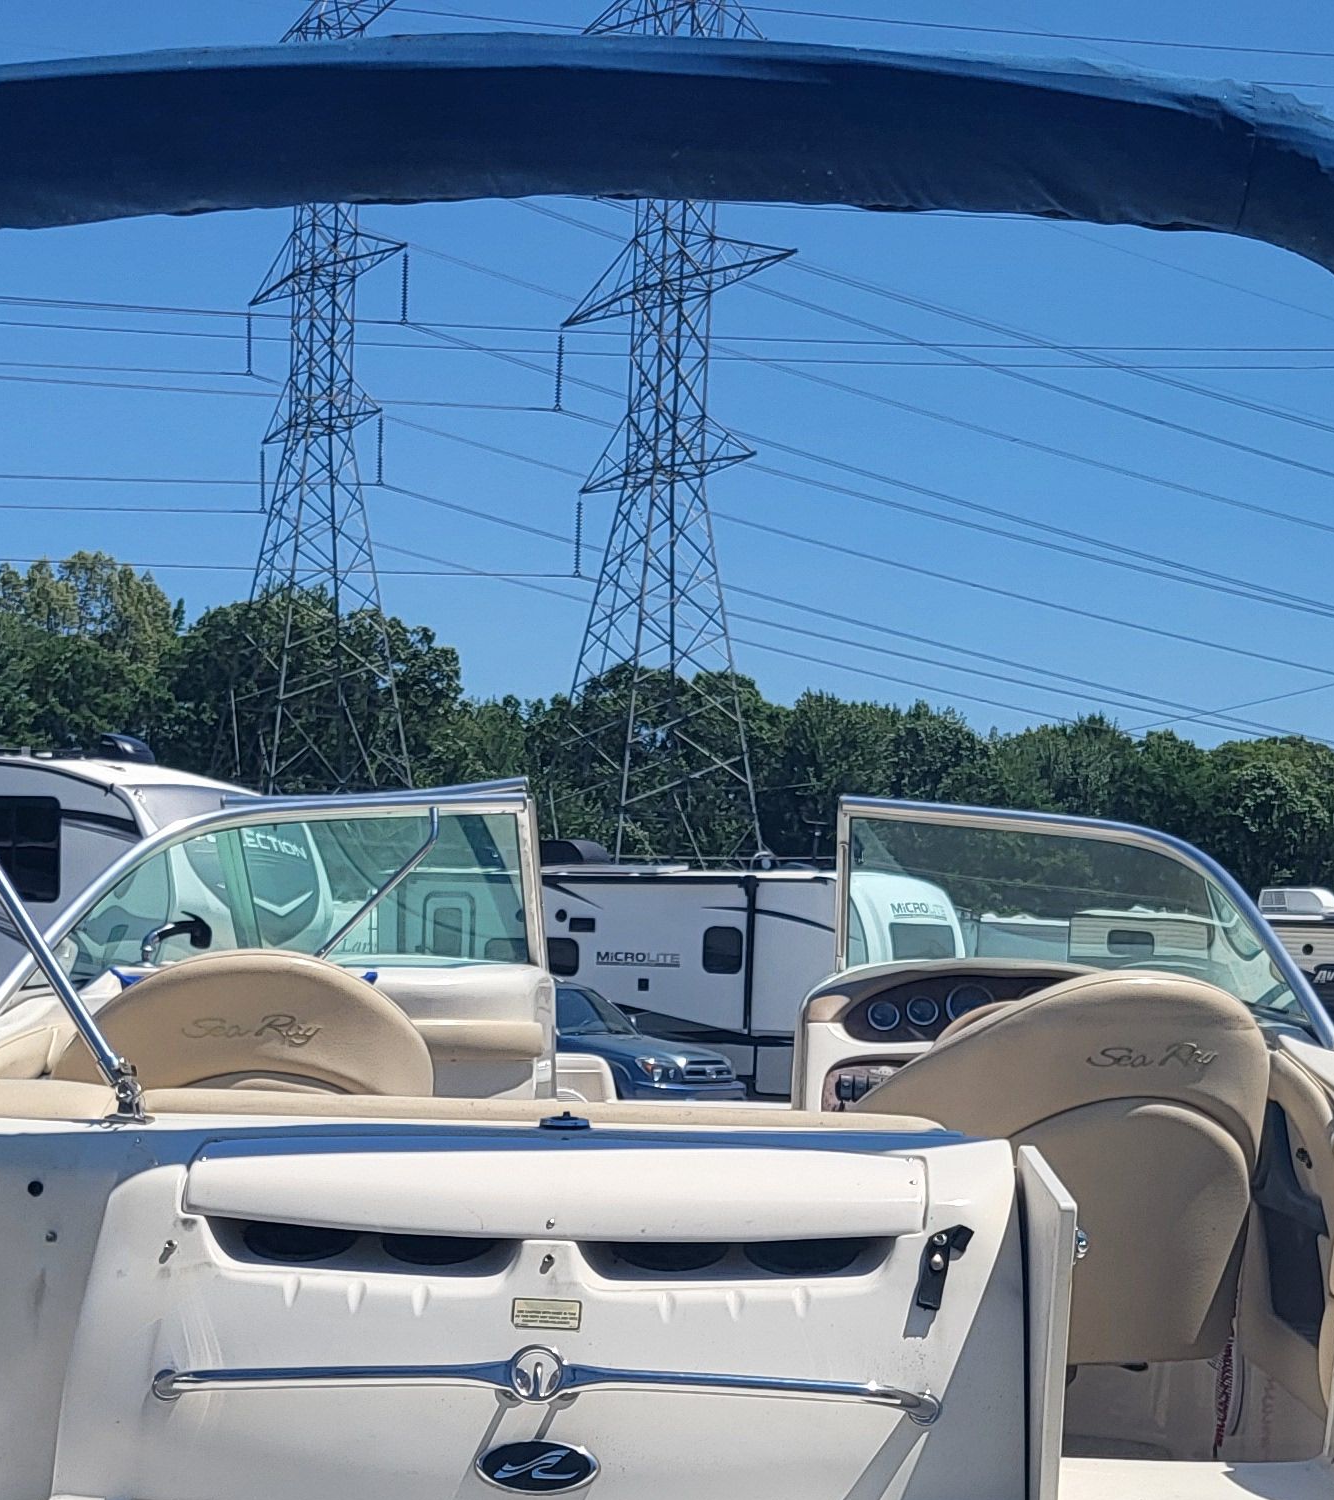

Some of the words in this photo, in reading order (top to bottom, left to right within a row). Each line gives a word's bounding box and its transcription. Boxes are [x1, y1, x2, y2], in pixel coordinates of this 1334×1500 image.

[182, 1017, 252, 1040] Sea
[253, 1013, 324, 1048] Ray
[1085, 1047, 1154, 1069] Sea
[1157, 1041, 1219, 1071] Ray
